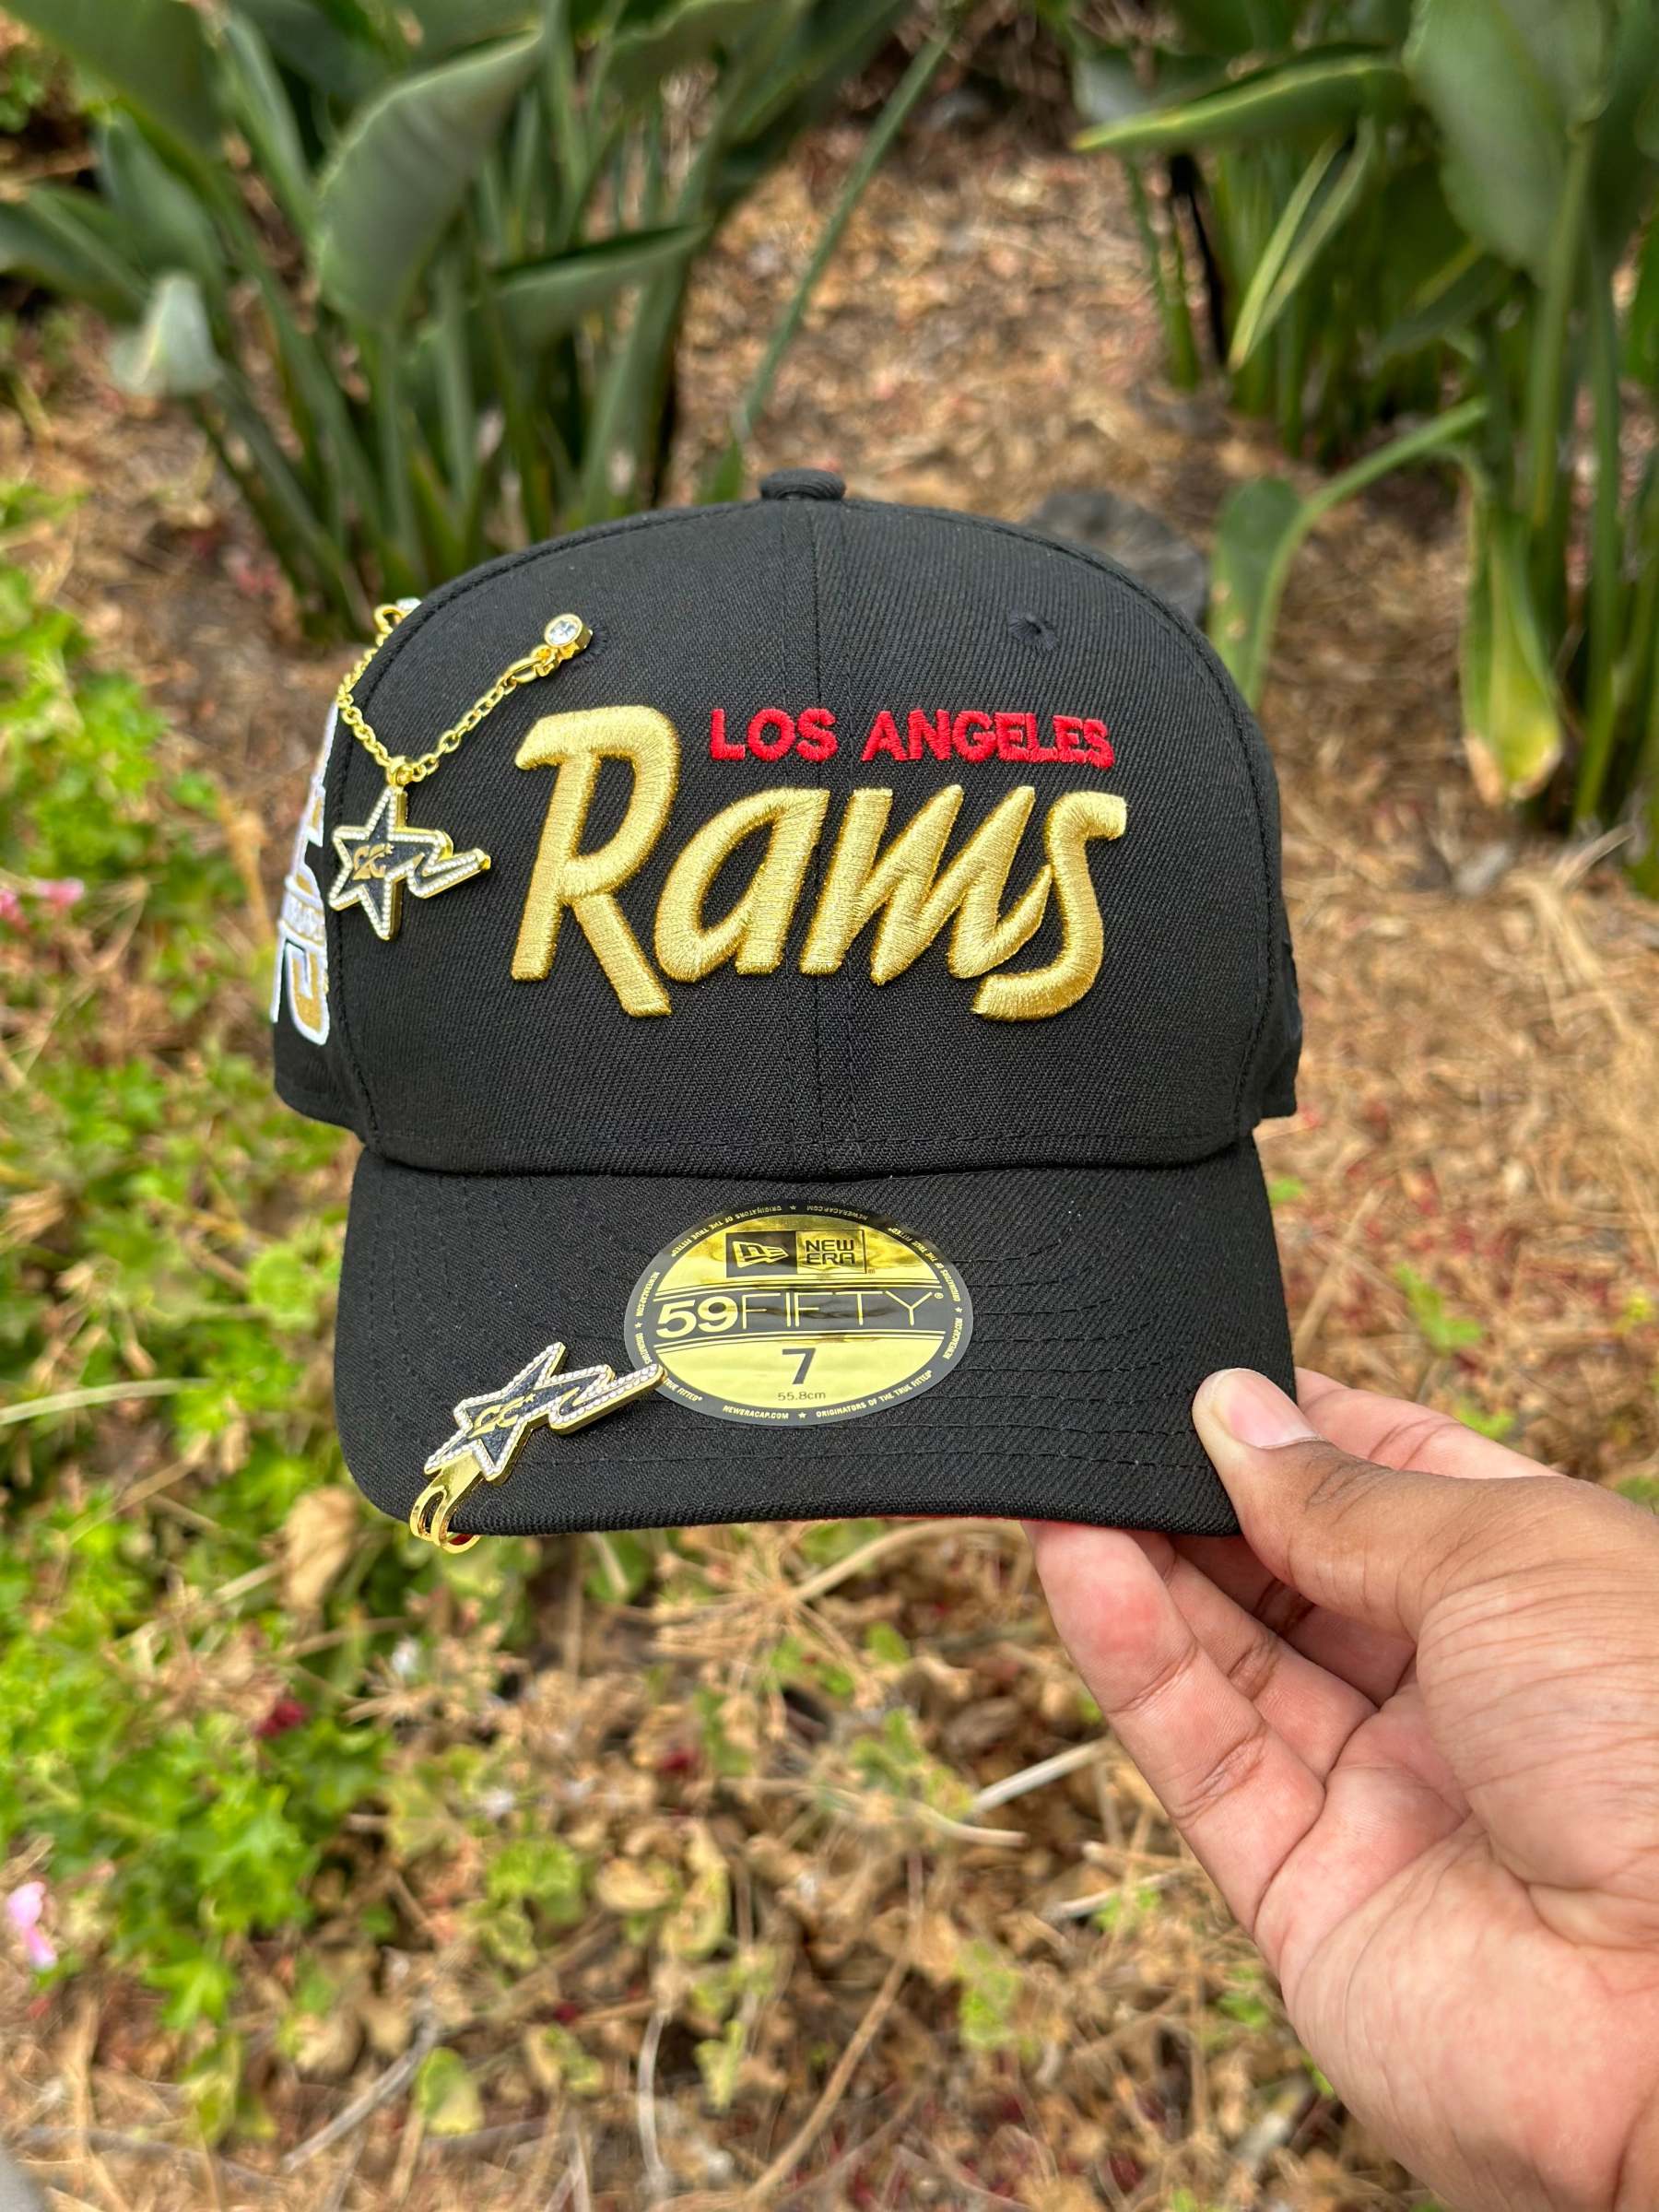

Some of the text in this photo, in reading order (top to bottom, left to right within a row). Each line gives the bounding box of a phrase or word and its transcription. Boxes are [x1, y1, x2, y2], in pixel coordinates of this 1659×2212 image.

[710, 708, 1114, 769] LOS ANGELES
[511, 705, 1127, 1019] Rams
[806, 1239, 854, 1252] NEW
[806, 1252, 856, 1265] ERA
[782, 1347, 816, 1385] 7
[777, 1390, 827, 1402] 55.8cm
[722, 1405, 789, 1419] NEWERACAP.COM
[815, 1402, 866, 1418] ORIGINATORS
